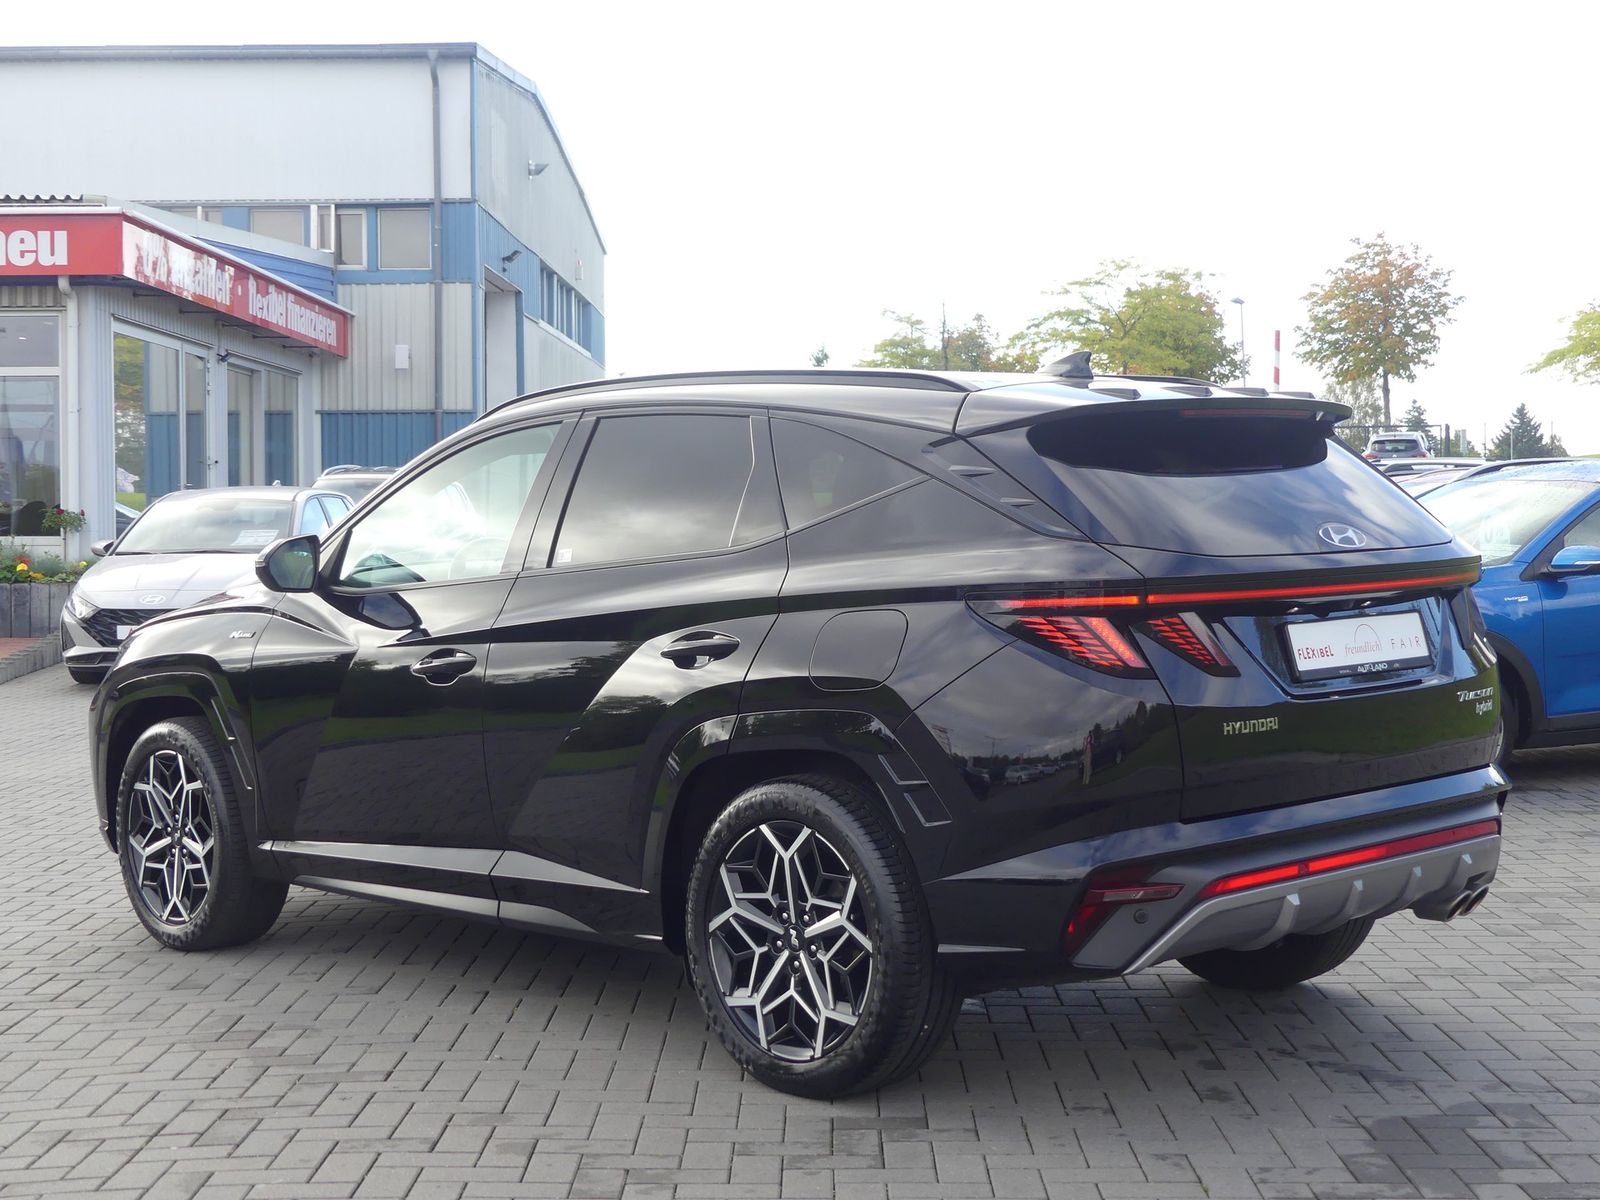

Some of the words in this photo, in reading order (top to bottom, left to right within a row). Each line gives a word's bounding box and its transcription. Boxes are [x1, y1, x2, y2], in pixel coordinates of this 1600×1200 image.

[0, 230, 68, 266] eu
[249, 274, 286, 328] flexibel
[287, 293, 336, 346] finanzieren
[1297, 645, 1334, 660] FLEXIBEL
[1390, 636, 1421, 650] FAIR
[1223, 716, 1279, 735] HYUNDAI
